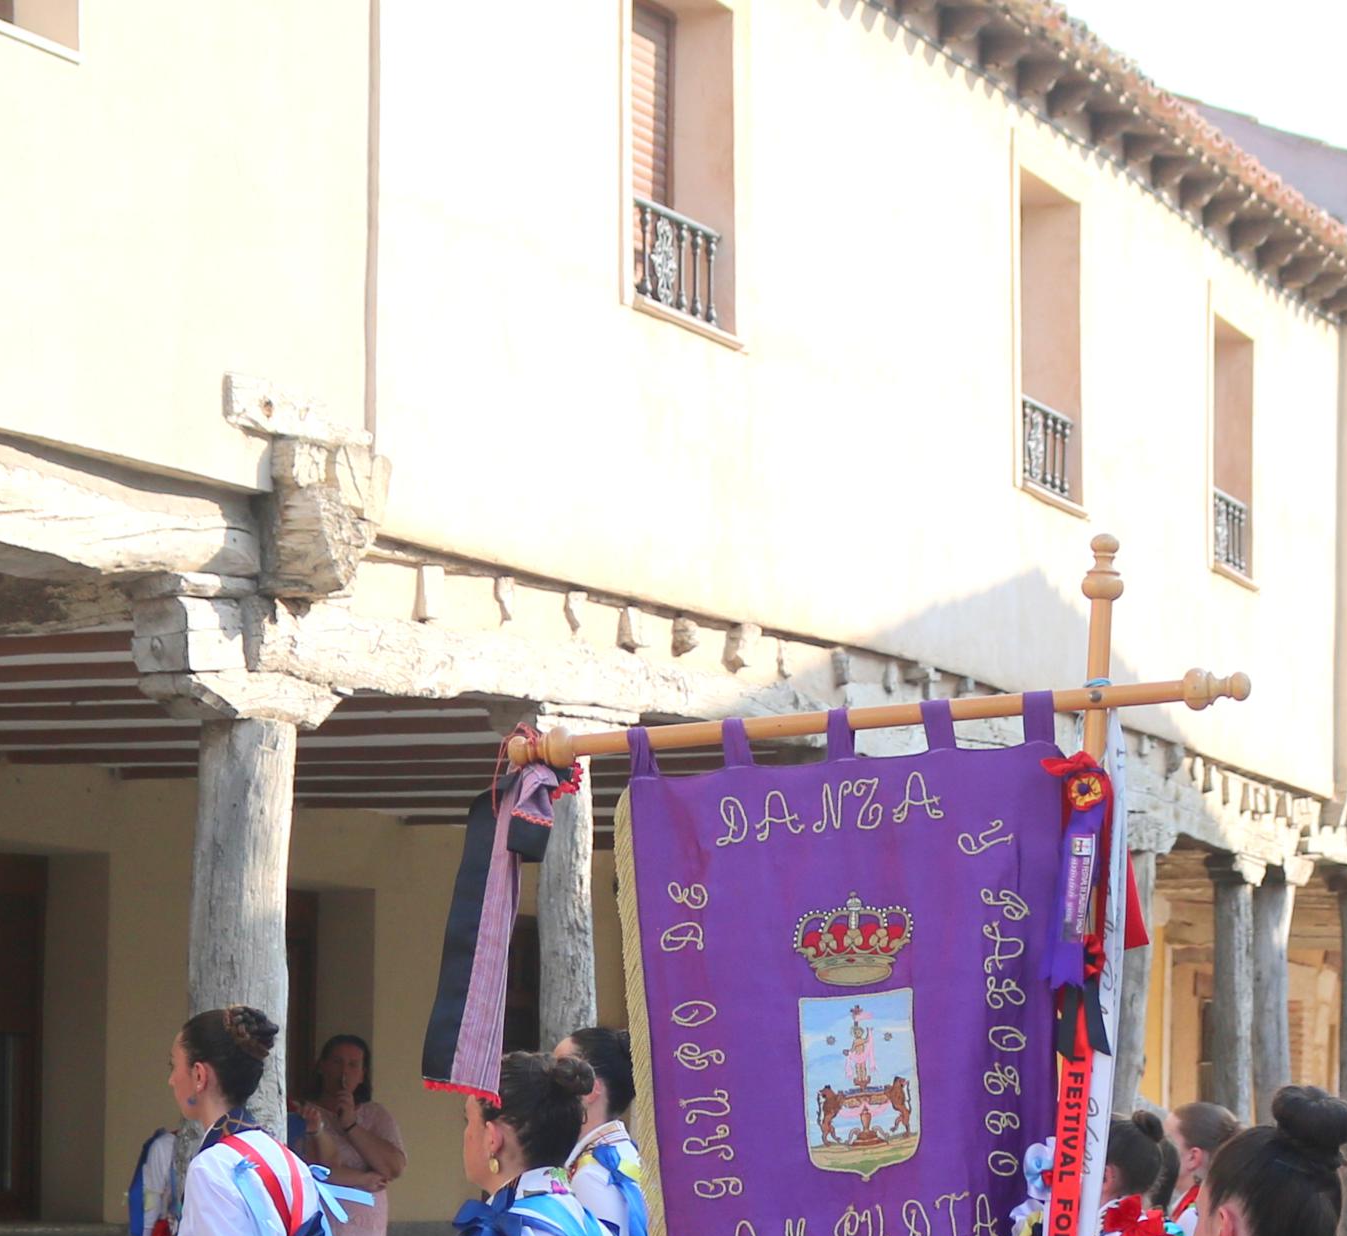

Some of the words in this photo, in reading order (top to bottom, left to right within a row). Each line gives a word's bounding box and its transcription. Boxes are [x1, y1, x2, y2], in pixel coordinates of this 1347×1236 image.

[715, 771, 944, 847] DANZA
[659, 881, 709, 952] DE
[980, 887, 1030, 1177] PALOTEO
[671, 999, 743, 1199] GRUPO
[1058, 1071, 1085, 1183] FESTIVAL
